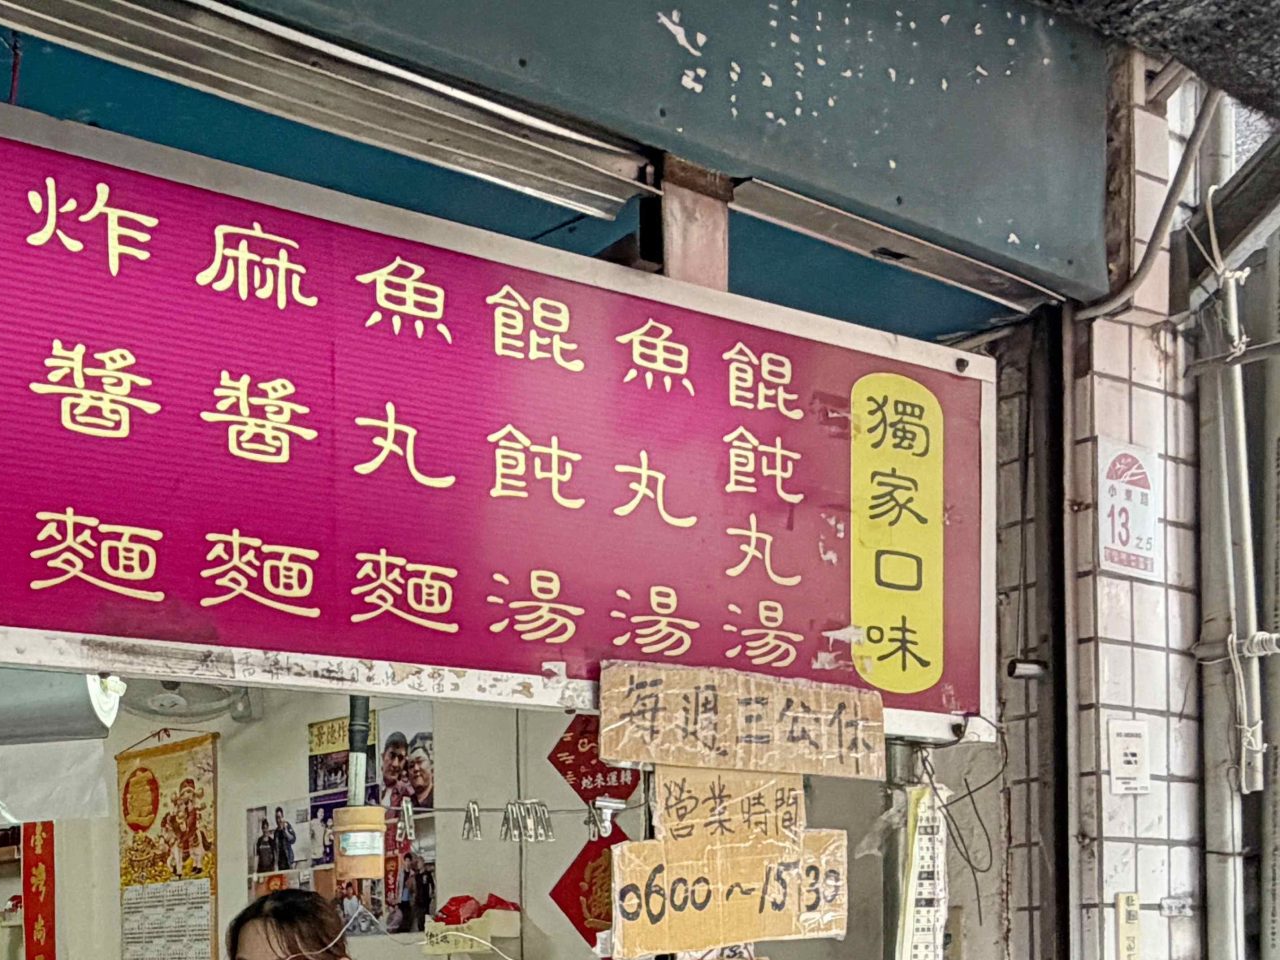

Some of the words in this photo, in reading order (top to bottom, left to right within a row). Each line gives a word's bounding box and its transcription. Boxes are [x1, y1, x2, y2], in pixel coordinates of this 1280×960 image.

[26, 177, 165, 602] 炸醬麵
[196, 223, 320, 619] 麻醬麵
[351, 256, 459, 634] 魚丸麵
[486, 284, 586, 644] 餛飩湯
[612, 319, 700, 656] 魚丸湯
[722, 342, 804, 667] 餛飩丸湯
[866, 395, 931, 672] 獨家口味
[1107, 503, 1130, 547] 13
[663, 777, 799, 840] 營業時間
